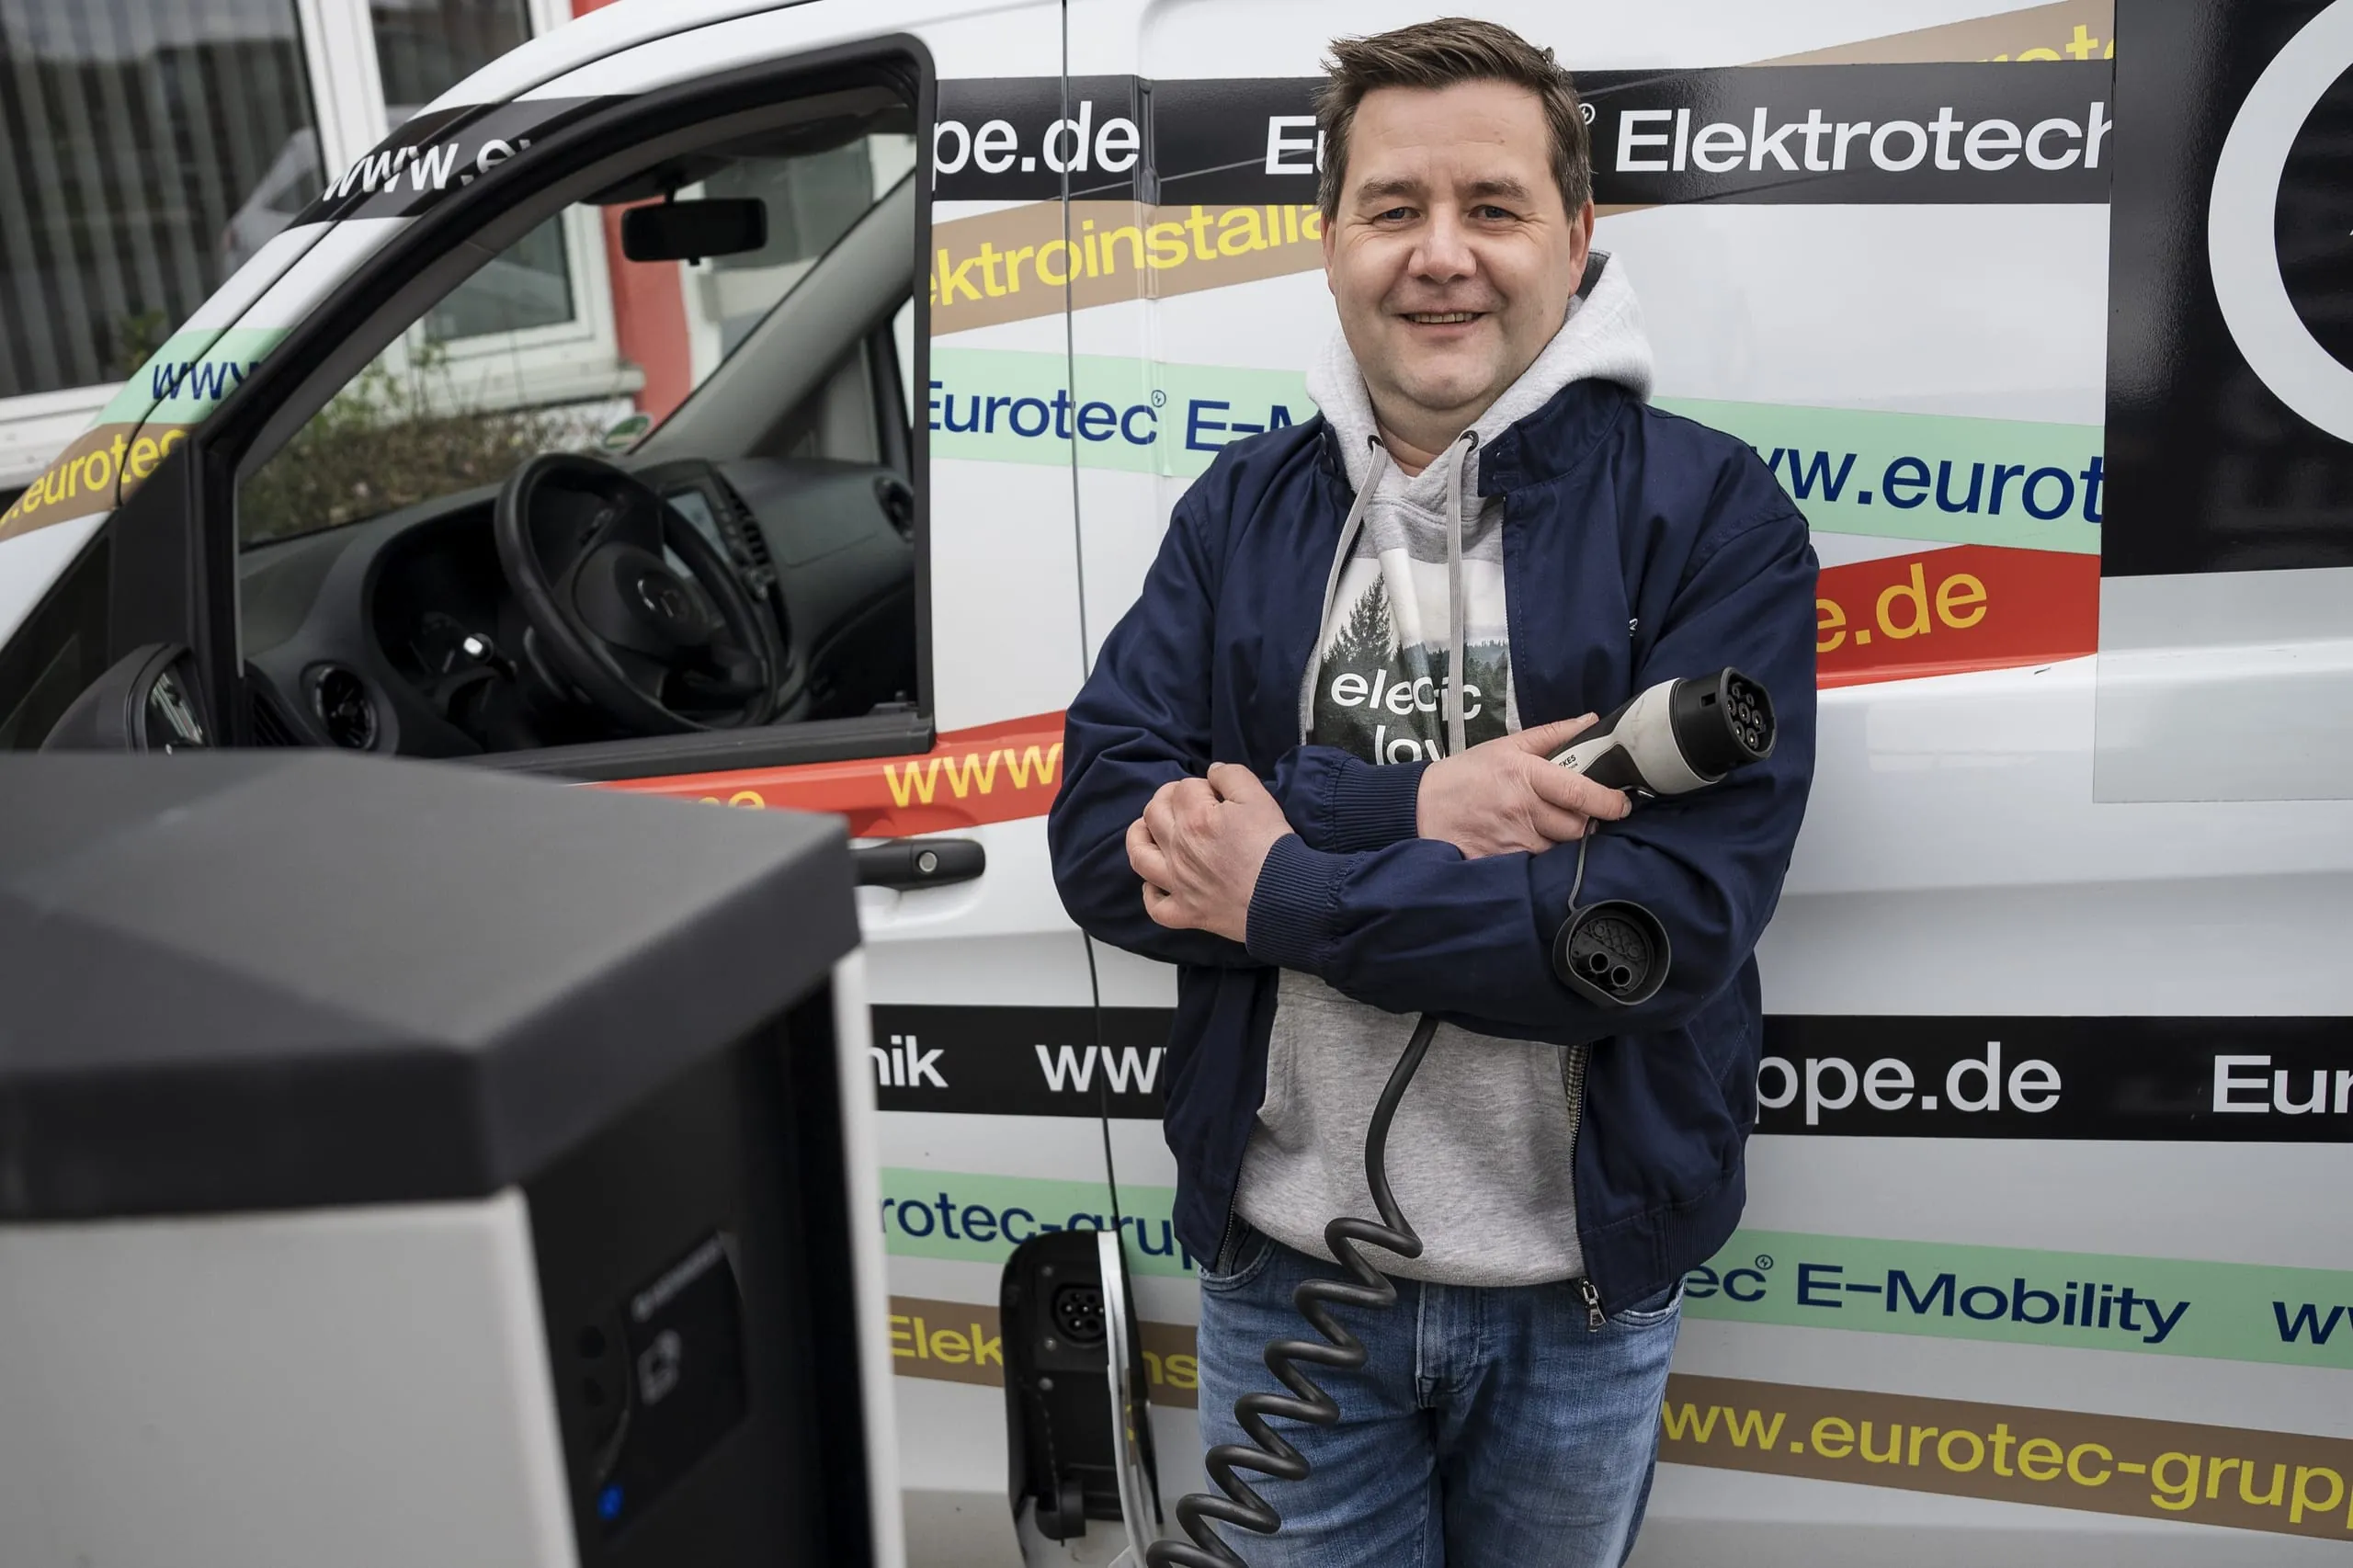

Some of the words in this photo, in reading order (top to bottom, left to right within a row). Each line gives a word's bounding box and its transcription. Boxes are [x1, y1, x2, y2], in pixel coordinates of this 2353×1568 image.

[323, 139, 530, 201] www.e
[884, 742, 1063, 808] www
[1035, 1044, 1166, 1094] ww
[1797, 1263, 2191, 1344] E-Mobility
[2272, 1301, 2353, 1345] w
[1661, 1401, 2353, 1530] ww.eurotec-grup
